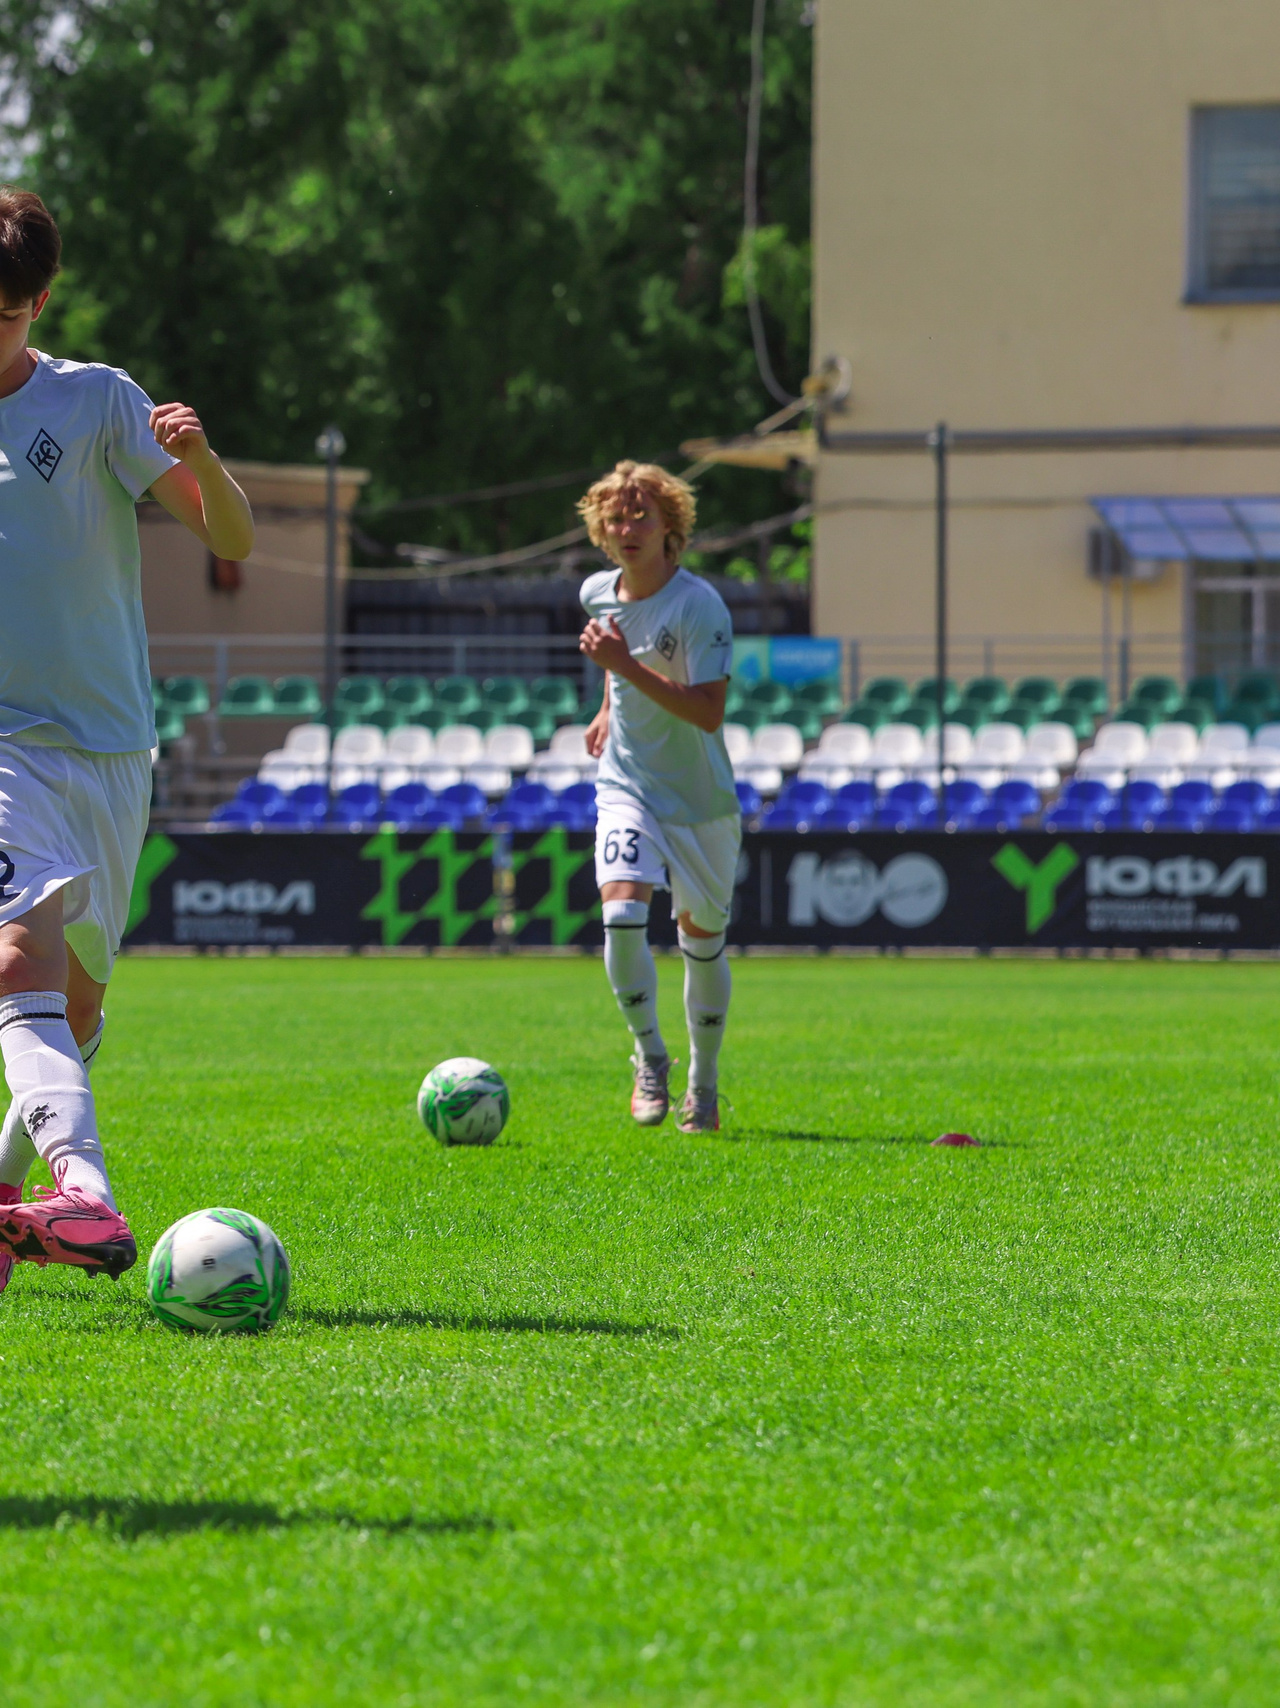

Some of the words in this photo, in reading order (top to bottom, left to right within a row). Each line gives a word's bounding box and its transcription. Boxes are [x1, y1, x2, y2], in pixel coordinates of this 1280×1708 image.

[604, 828, 640, 865] 63
[1086, 855, 1267, 898] ЮФЛ
[173, 880, 316, 915] ЮФЛ
